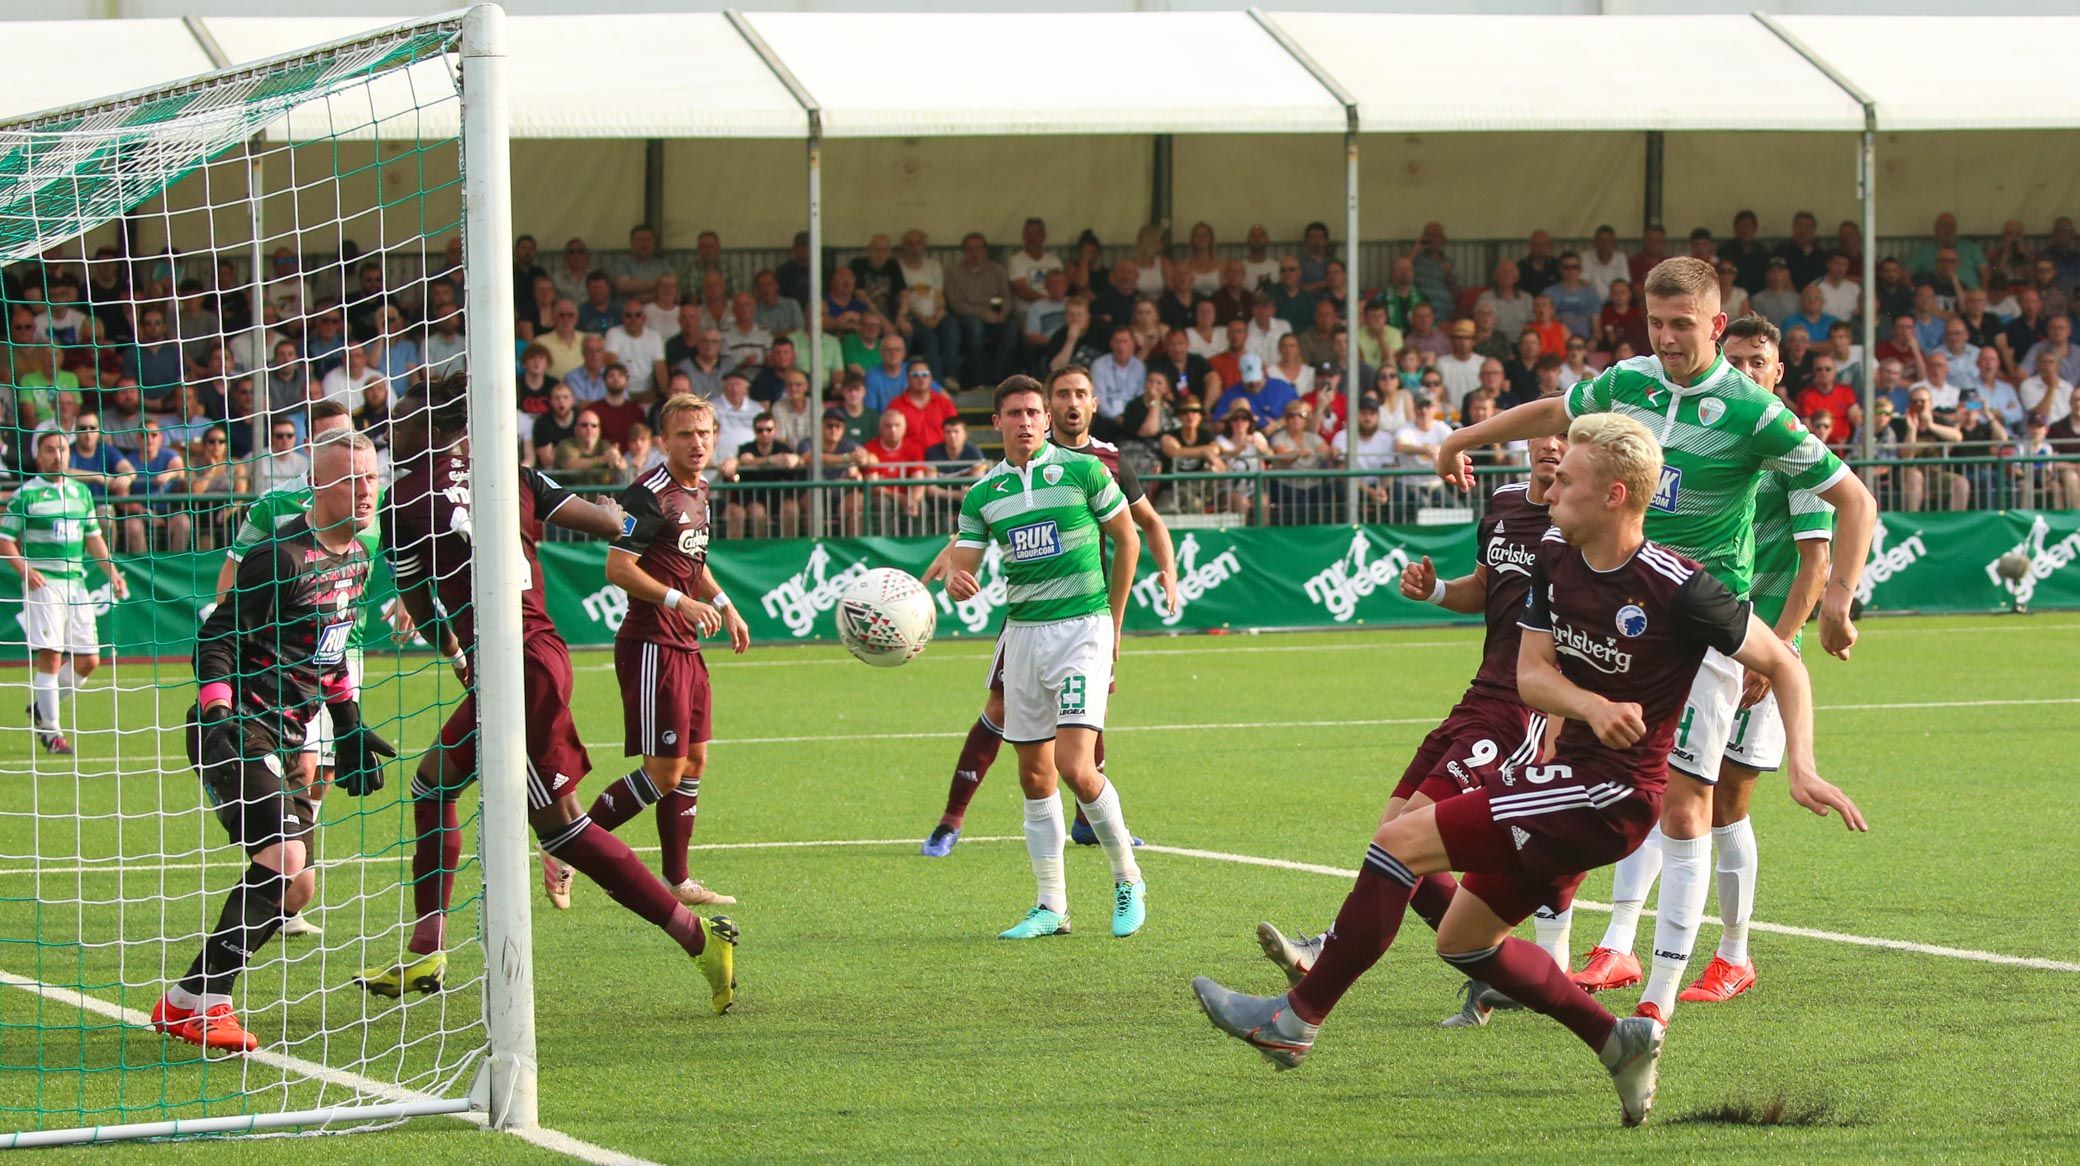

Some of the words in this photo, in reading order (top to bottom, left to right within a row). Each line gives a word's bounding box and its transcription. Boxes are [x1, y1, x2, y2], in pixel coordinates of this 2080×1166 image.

[1015, 524, 1055, 551] RUK
[1016, 545, 1055, 559] GROUP.COM
[1487, 536, 1536, 567] Carlsbe
[1059, 675, 1086, 709] 23
[1462, 738, 1498, 769] 9
[1671, 747, 1695, 763] GEA
[1725, 741, 1744, 754] GEA
[1525, 764, 1573, 784] 5
